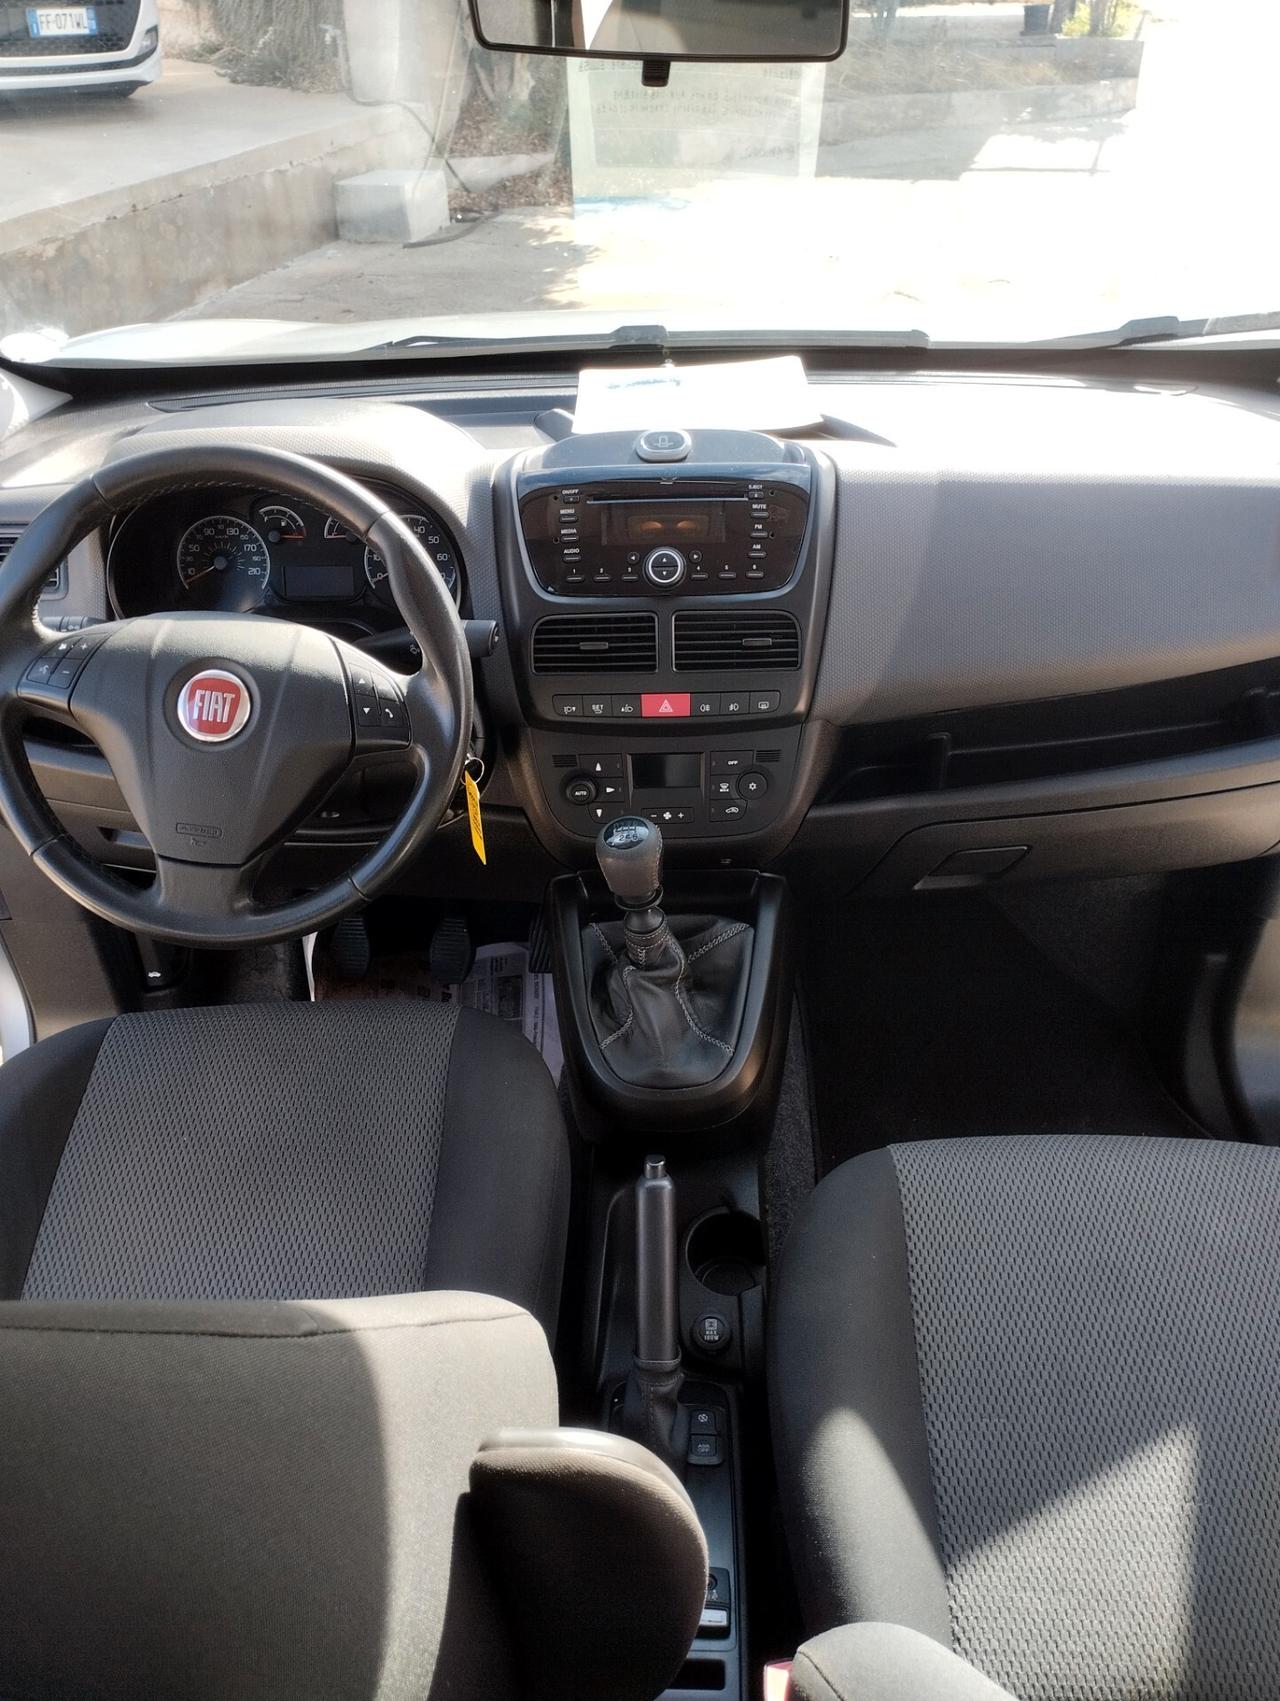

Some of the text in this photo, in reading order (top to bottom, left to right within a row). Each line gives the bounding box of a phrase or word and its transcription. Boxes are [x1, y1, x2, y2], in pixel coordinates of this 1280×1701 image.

[427, 535, 440, 544] 50
[188, 544, 200, 552] 50
[243, 544, 257, 552] 170
[436, 553, 448, 561] 60
[247, 567, 261, 576] 210
[192, 688, 236, 723] FIAT
[619, 834, 625, 842] 2
